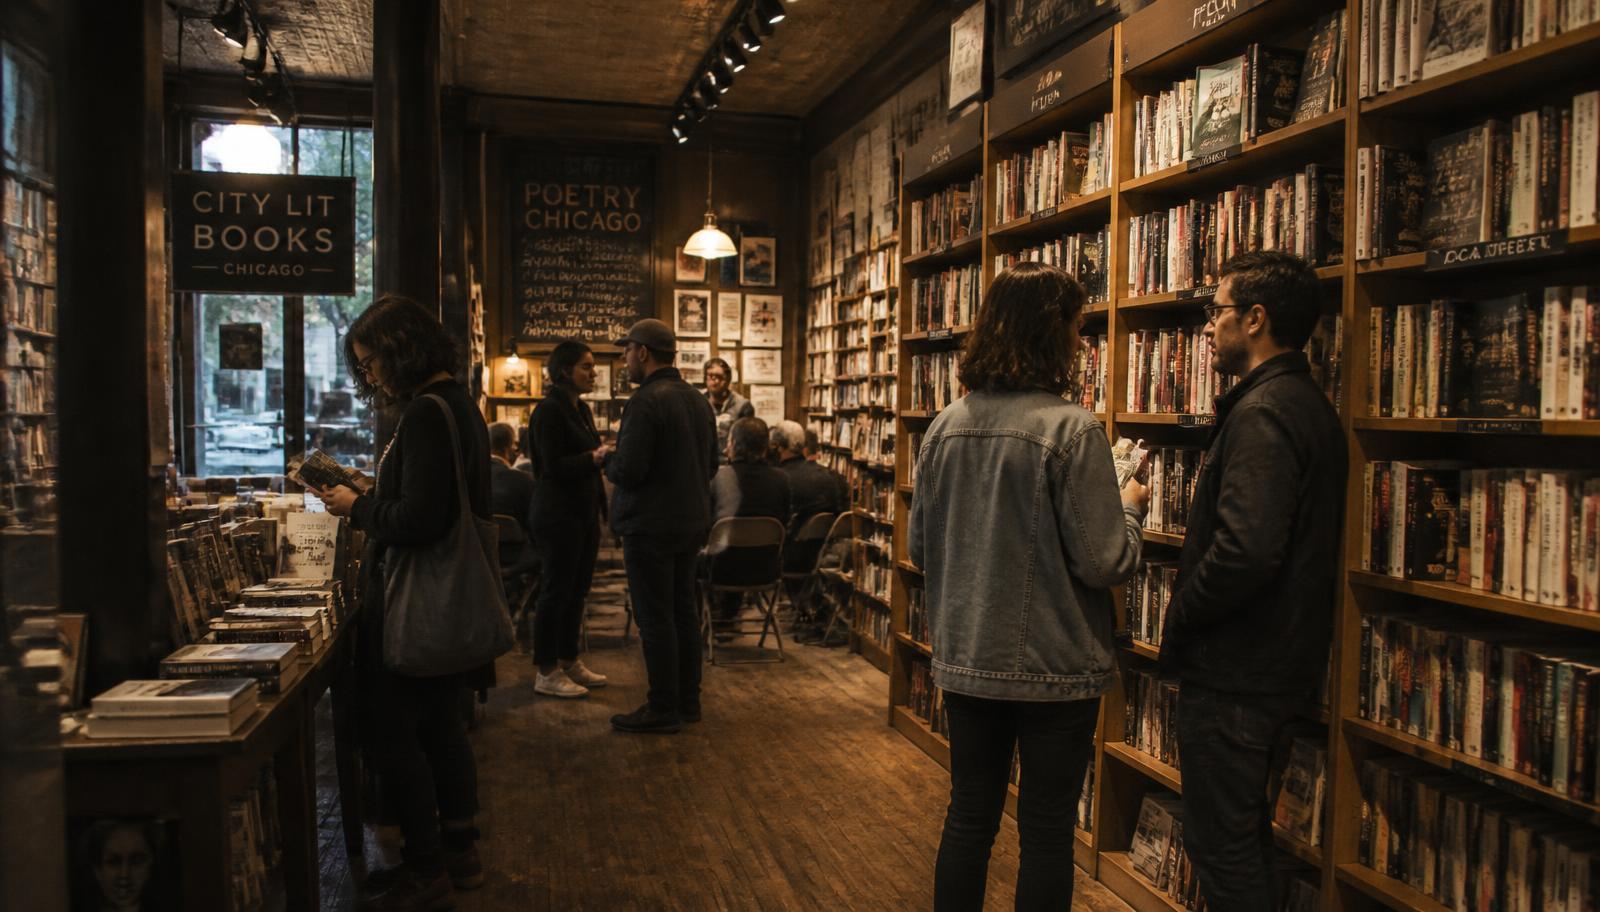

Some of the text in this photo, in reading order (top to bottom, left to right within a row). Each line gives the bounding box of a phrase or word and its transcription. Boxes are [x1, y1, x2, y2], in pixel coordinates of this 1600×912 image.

[192, 191, 335, 217] CITY LIT
[525, 182, 641, 209] POETRY
[525, 209, 641, 233] CHICAGO
[194, 224, 334, 253] BOOKS
[223, 263, 305, 277] CHICAGO
